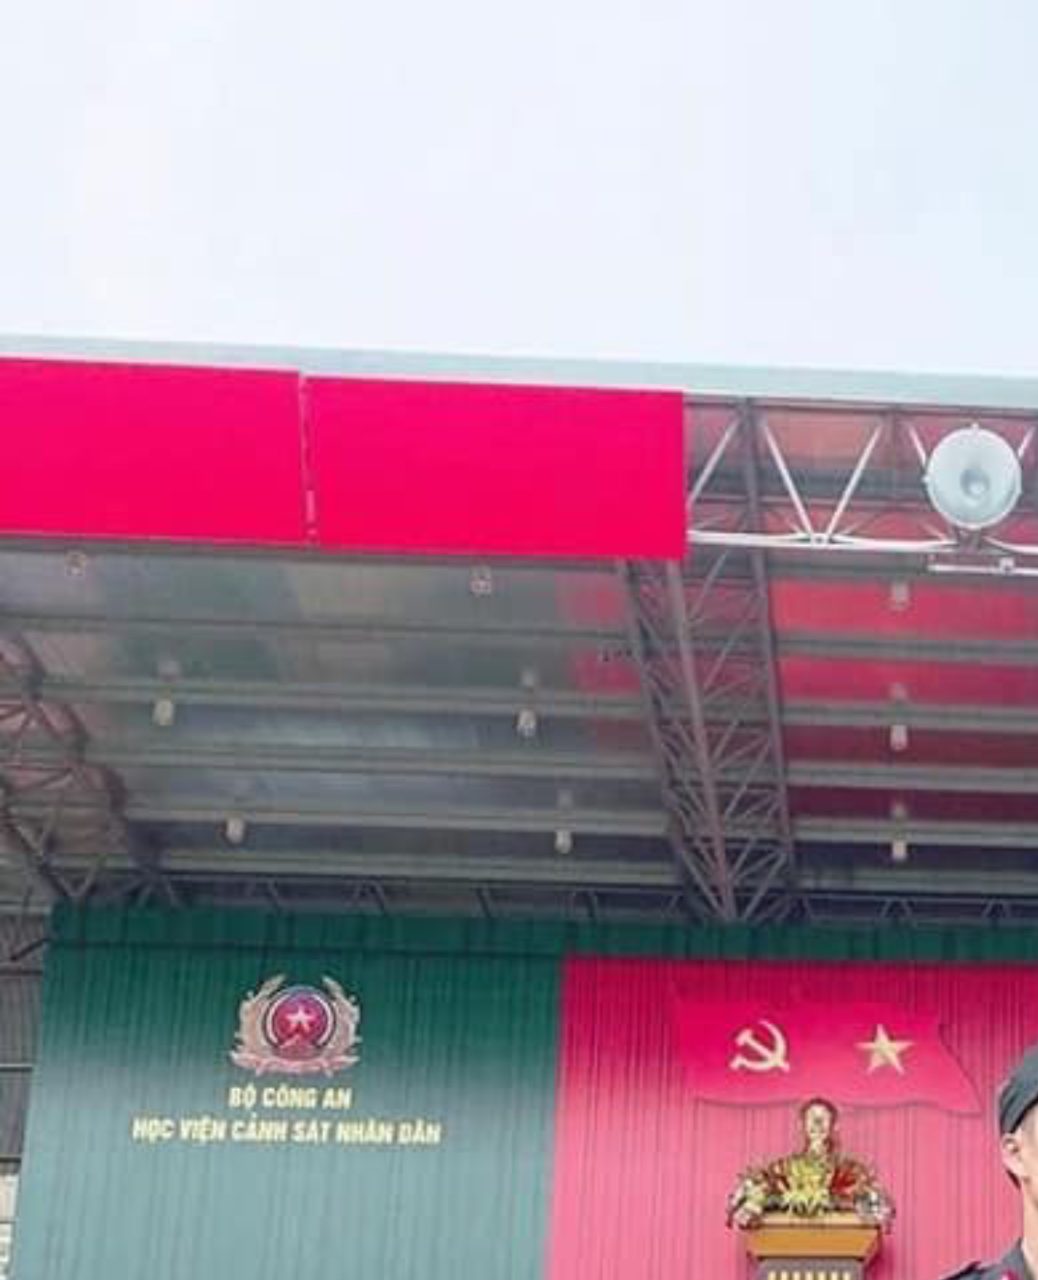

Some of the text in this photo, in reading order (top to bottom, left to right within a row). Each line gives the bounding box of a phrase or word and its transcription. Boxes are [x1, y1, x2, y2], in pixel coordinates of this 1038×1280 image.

[228, 1081, 352, 1110] BỘ CÔNG AN
[132, 1111, 442, 1147] HỌC VIỆN CẢNH SÁT NHÂN DÂN
